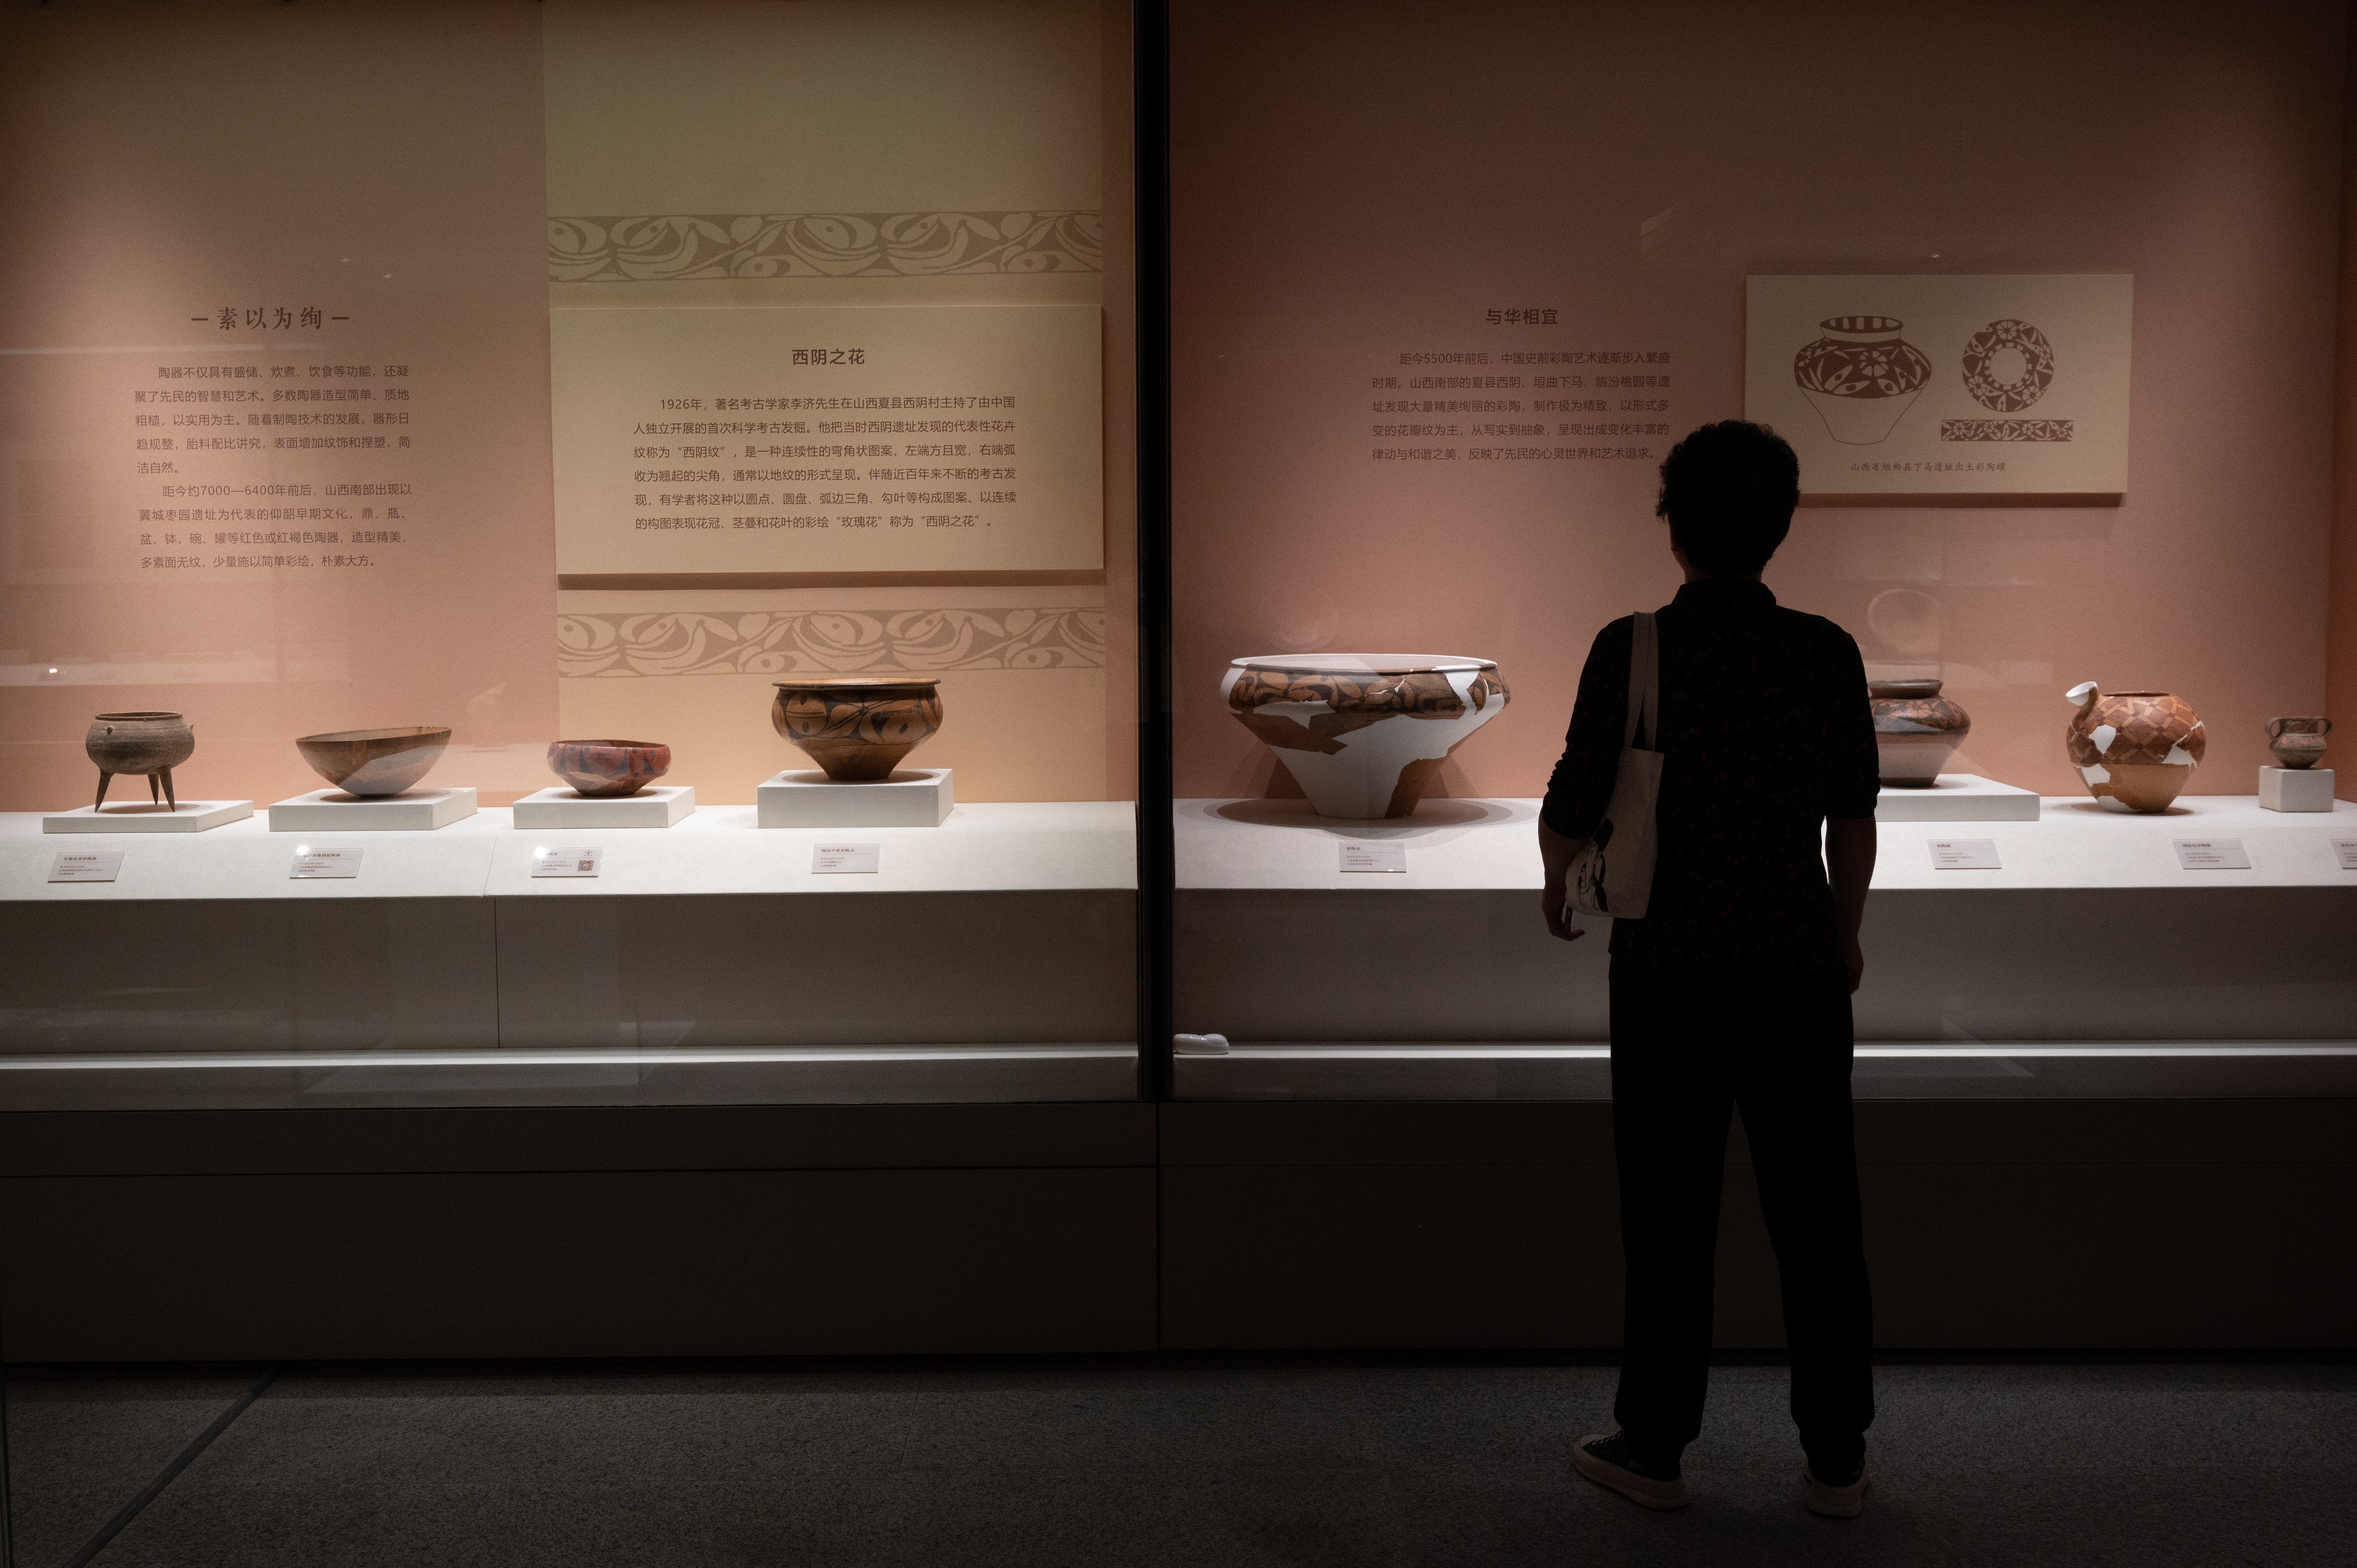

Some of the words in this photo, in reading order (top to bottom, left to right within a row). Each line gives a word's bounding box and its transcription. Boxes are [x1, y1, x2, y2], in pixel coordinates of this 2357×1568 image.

[216, 306, 322, 330] 素以为绚
[1486, 308, 1558, 325] 与华相宜
[792, 348, 865, 365] 西阴之花
[1399, 352, 1670, 365] 距今5500年前后，中国史前彩陶艺术逐渐步入繁盛
[158, 365, 408, 379] 陶器不仅具有盛储、炊煮、饮食等功能，还凝
[1372, 375, 1669, 389] 时期。山西南部的夏县西阴、垣曲下马、临汾桃园等遗
[135, 388, 409, 403] 聚了先民的智慧和艺术。多数陶器造型简单、质地
[660, 396, 1015, 410] 1926年，著名考古学家李济先生在山西夏县西阴村主持了由中国
[1372, 399, 1669, 413] 址发现大量精美绚丽的彩陶，制作极为精致，以形式多
[135, 413, 409, 426] 粗糙，以实用为主。随着制陶技术的发展，器形日
[633, 420, 1015, 435] 人独立开展的首次科学考古发掘。他把当时西阴遗址发现的代表性花卉
[1372, 423, 1669, 437] 变的花瓣纹为主，从写实到抽象，呈现出成变化丰富的
[136, 436, 410, 450] 趋规整，胎料配比讲究，表面增加纹饰和捏塑，简
[1372, 447, 1653, 460] 律动与和谐之美，反映了先民的心灵世界和艺术追求。
[137, 462, 178, 474] 洁自然。
[1851, 462, 2005, 472] 山西省垣曲县下马遗址出土彩陶罐
[635, 467, 1016, 482] 收为翘起的尖角，通常以地纹的形式呈现。伴随近百年来不断的考古发
[635, 491, 1016, 506] 现，有学者将这种以圆点、圆盘、弧边三角、勾叶等构成图案、以连续
[139, 507, 406, 521] 翼城枣园遗址为代表的仰韶早期文化，鼎、瓶、
[140, 531, 406, 545] 盆、钵、碗、罐等红色或红褐色陶器，造型精美，
[141, 554, 374, 569] 多素面无纹，少量施以简单彩绘，朴素大方。
